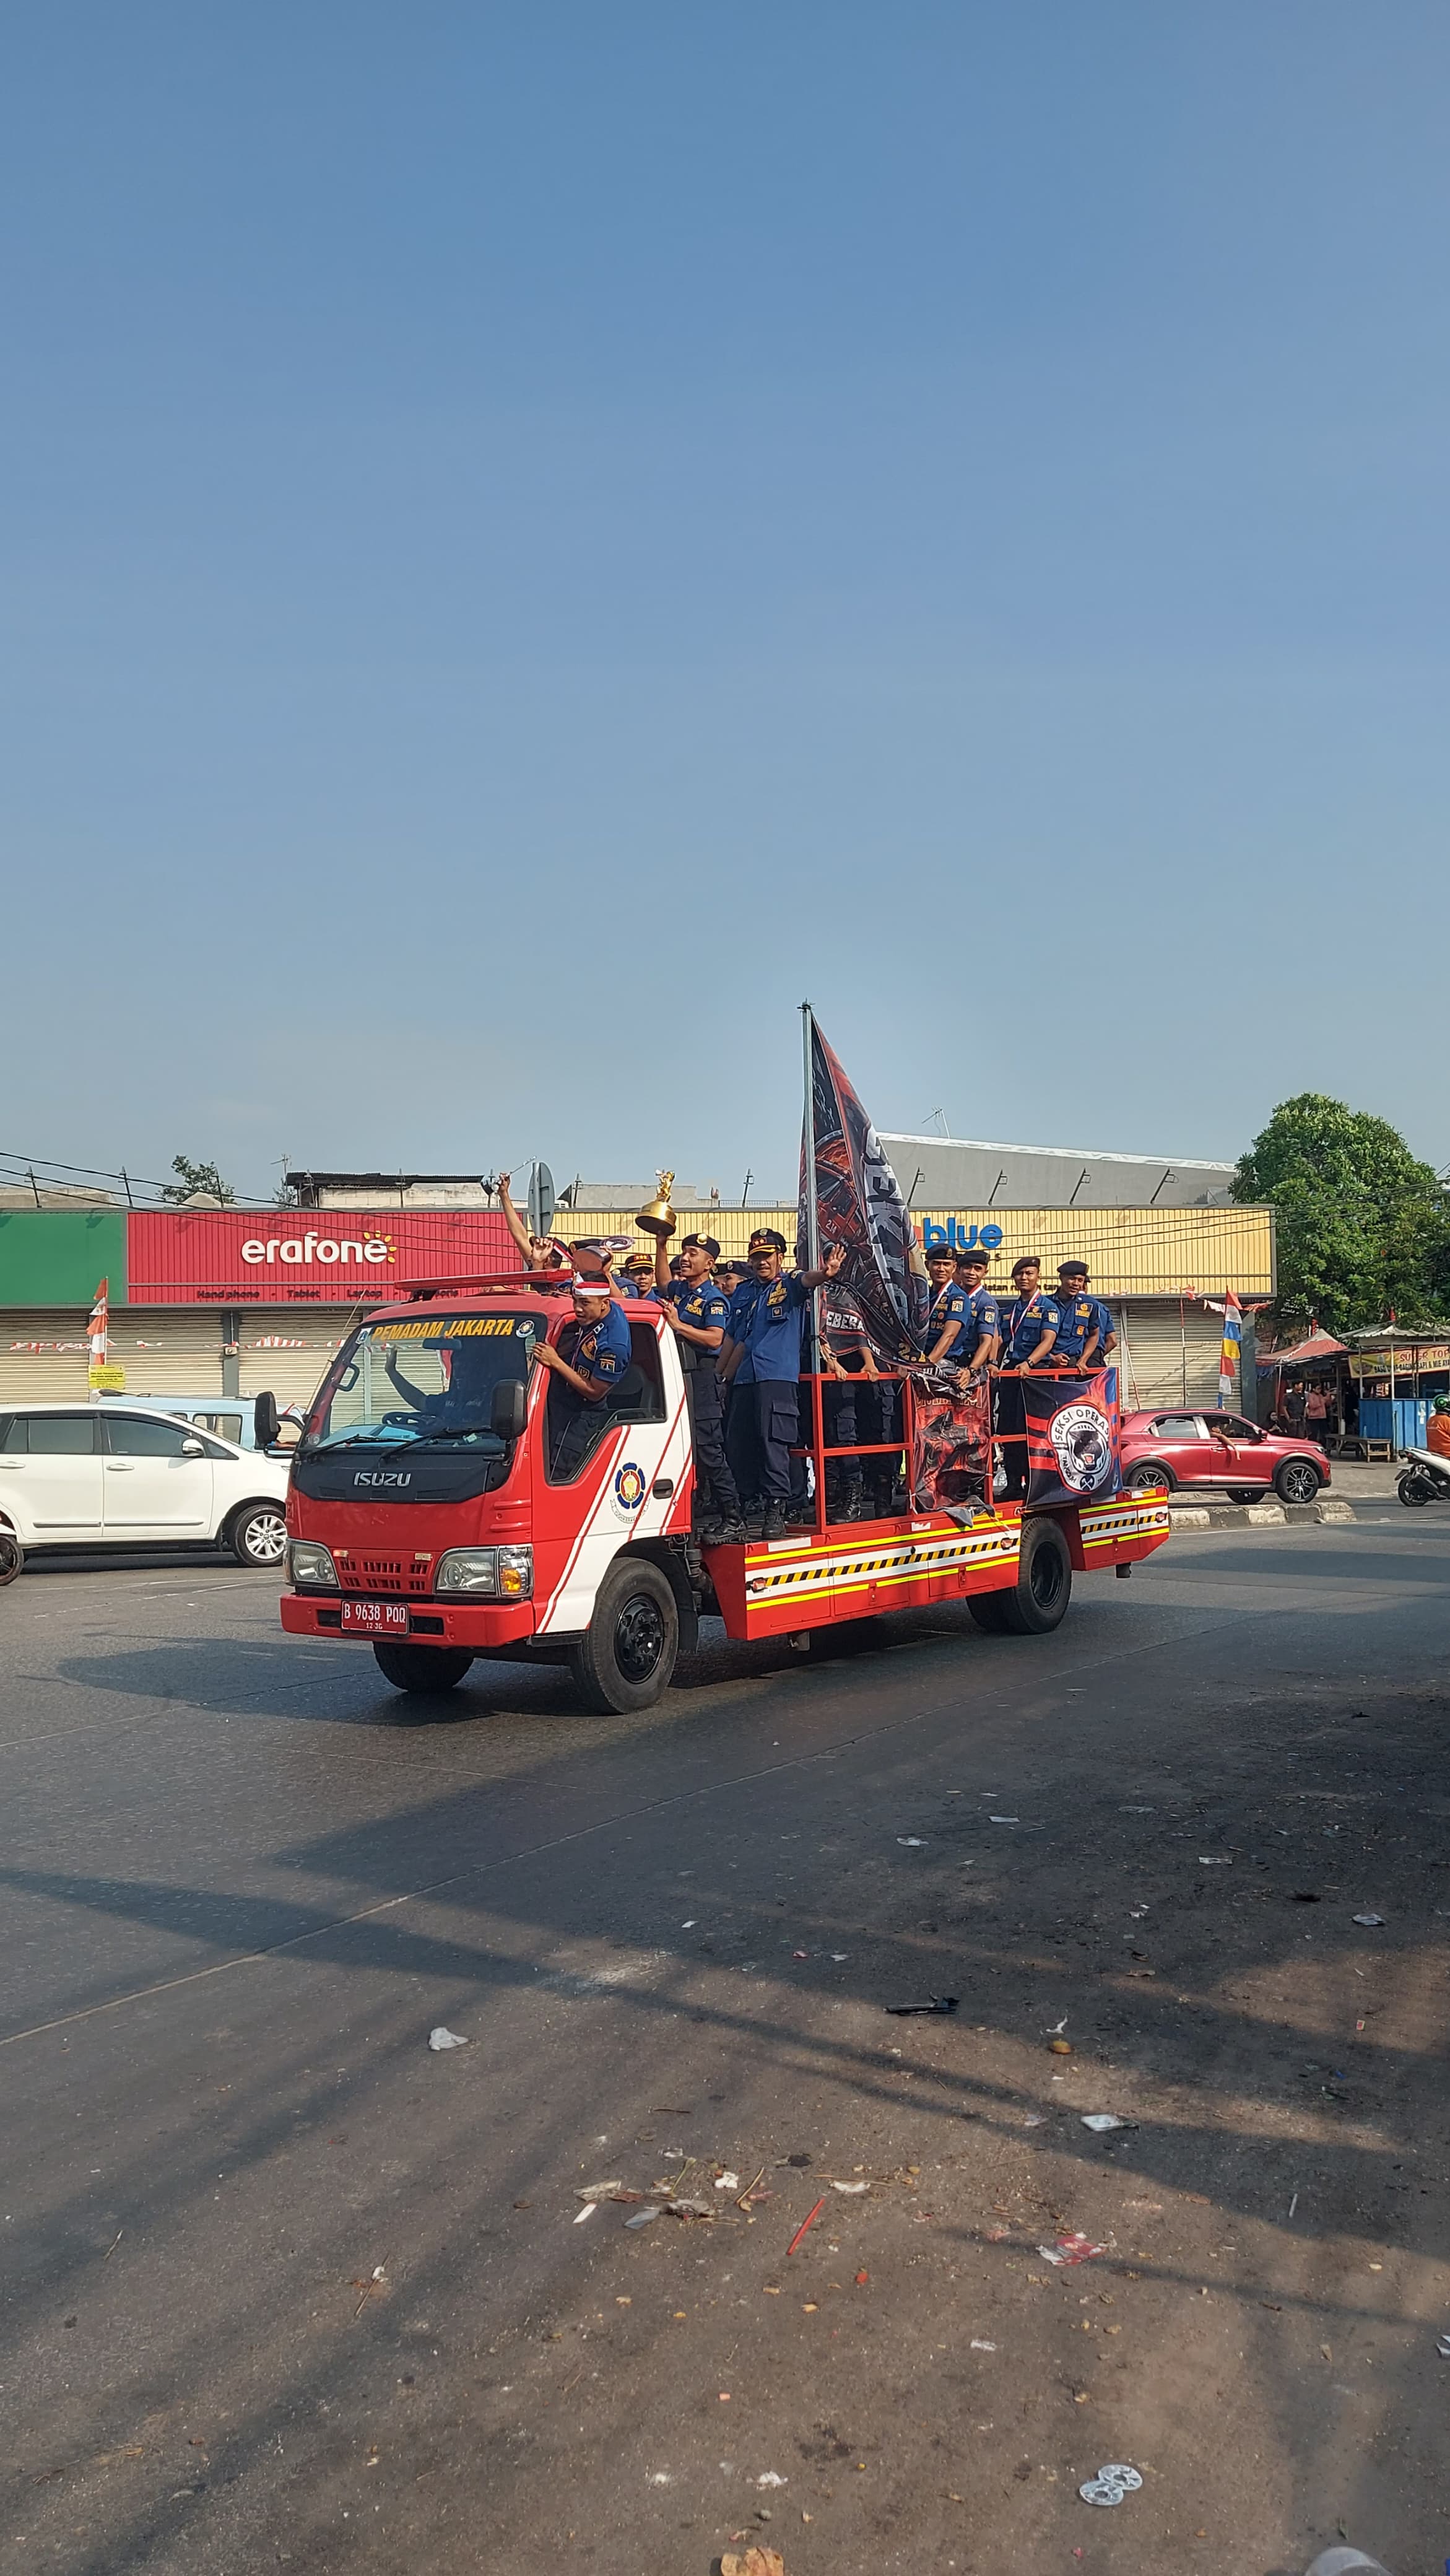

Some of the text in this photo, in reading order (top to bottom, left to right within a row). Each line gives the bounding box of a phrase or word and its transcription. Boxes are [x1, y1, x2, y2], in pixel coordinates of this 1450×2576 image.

[924, 1217, 1003, 1250] blue
[241, 1231, 388, 1264] erafone
[197, 1290, 225, 1298] Hand
[226, 1290, 260, 1300] phone
[287, 1290, 321, 1298] Tablet
[373, 1319, 515, 1341] PEMADAM JAKARTA
[1054, 1409, 1109, 1442] SEKSI OPERAS
[354, 1472, 411, 1487] ISUZU
[344, 1603, 351, 1619] B
[355, 1604, 381, 1621] 9638
